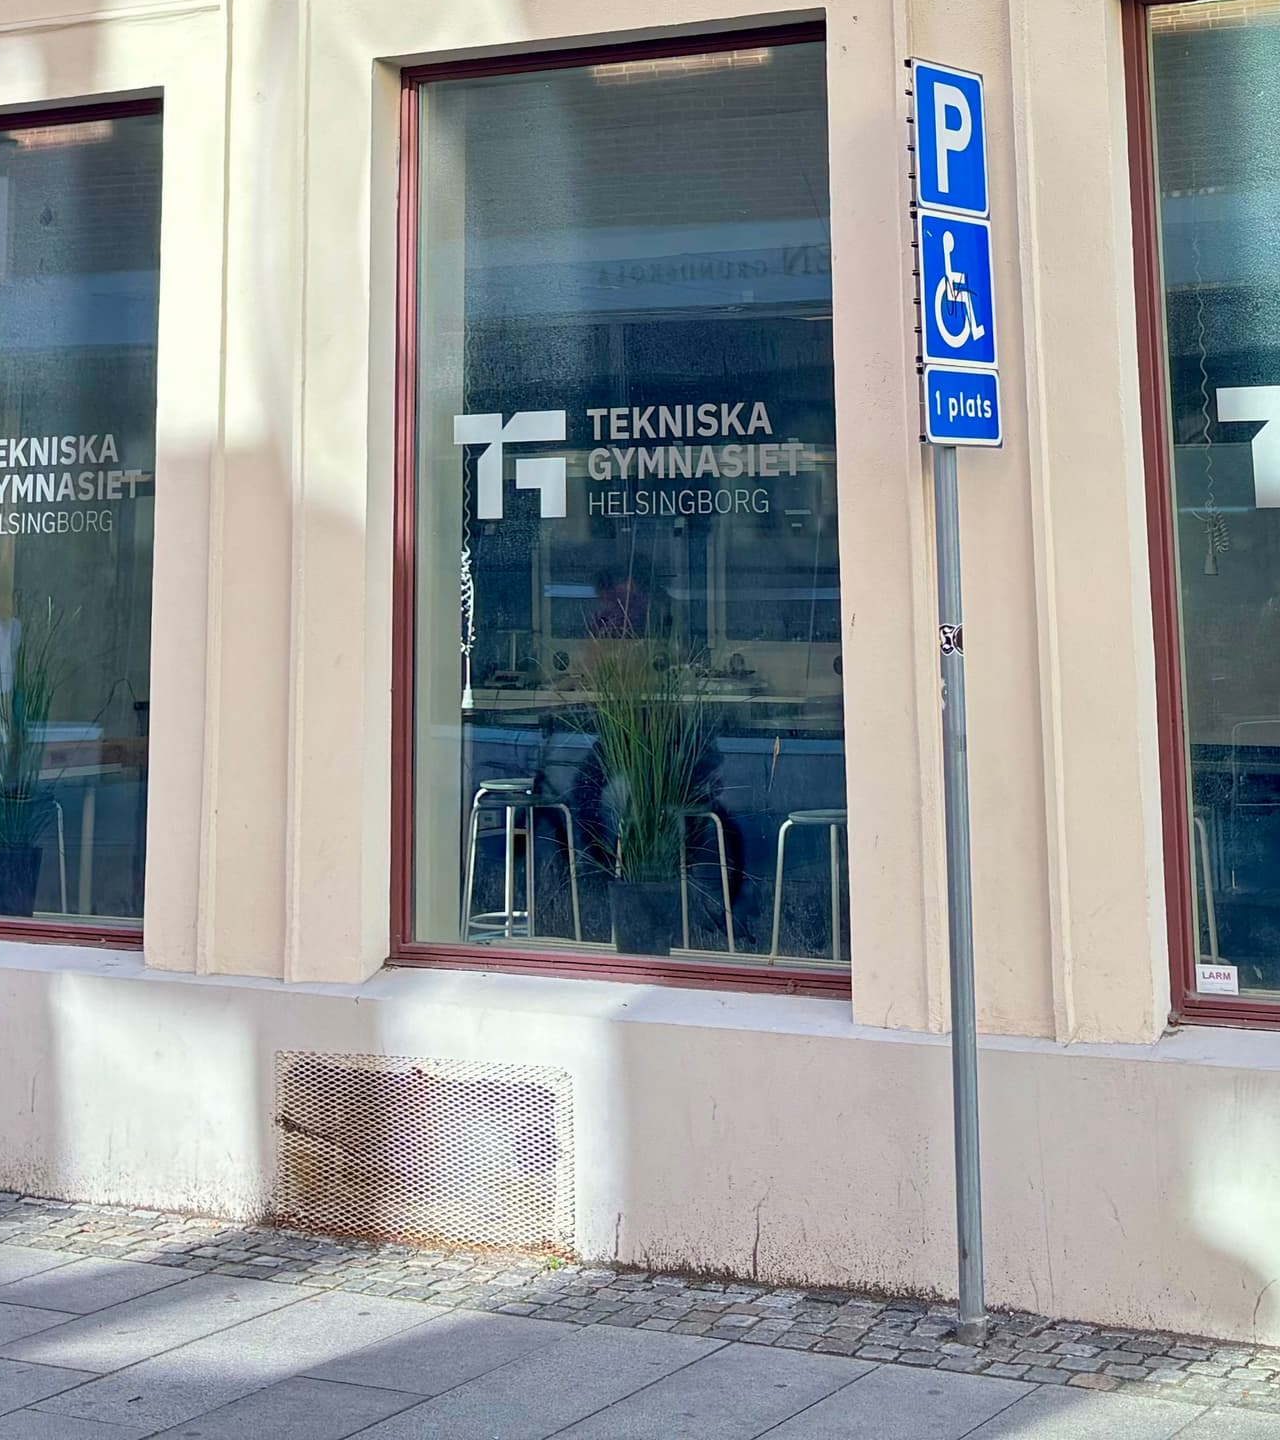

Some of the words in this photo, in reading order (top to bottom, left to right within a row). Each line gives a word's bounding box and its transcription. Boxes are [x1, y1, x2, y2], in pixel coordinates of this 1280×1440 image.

[933, 81, 973, 194] P
[586, 401, 774, 441] TEKNISKA
[935, 389, 941, 416] 1
[948, 391, 992, 423] plats
[587, 442, 805, 481] GYMNASIET
[588, 488, 770, 516] HELSINGBORG
[1202, 970, 1232, 981] LARM
